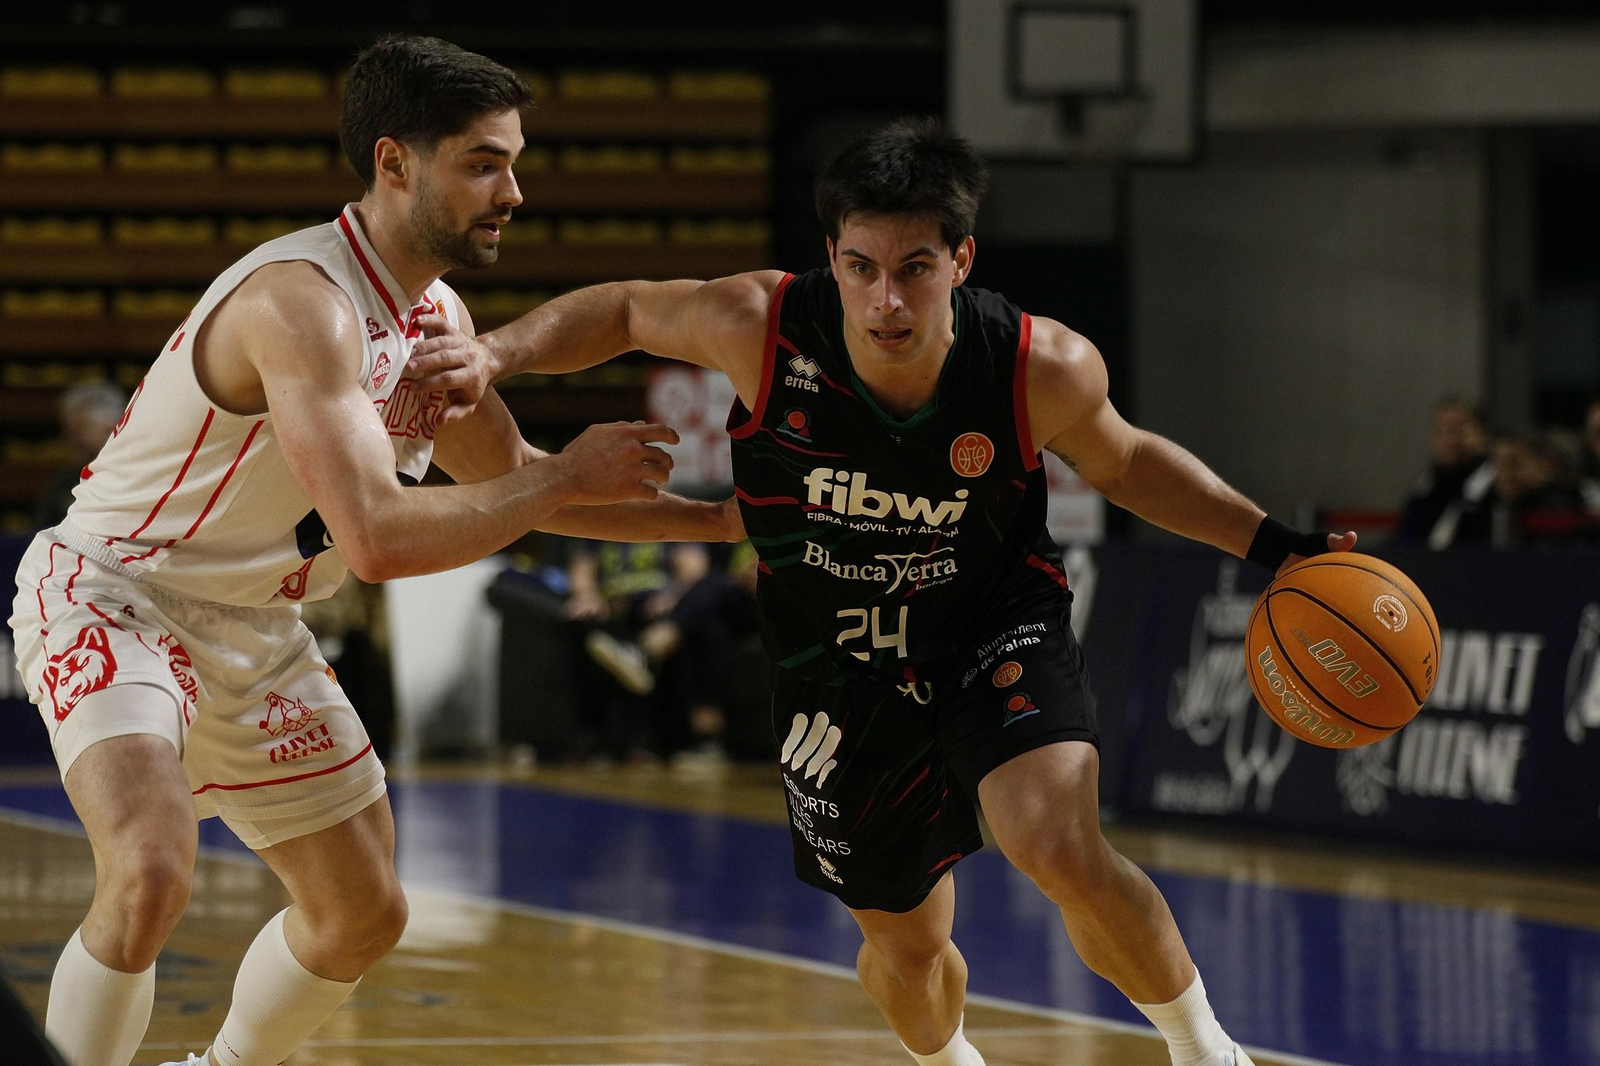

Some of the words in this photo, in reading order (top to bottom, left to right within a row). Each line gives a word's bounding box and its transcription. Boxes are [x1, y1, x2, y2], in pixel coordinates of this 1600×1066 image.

[785, 375, 819, 393] errea
[803, 467, 969, 527] fibwi
[806, 512, 842, 526] FIBRA
[850, 520, 889, 533] MÓVIL
[896, 525, 912, 536] TV
[836, 605, 908, 661] 24
[1257, 645, 1356, 745] Wilson
[1307, 638, 1380, 698] EVO
[269, 722, 329, 764] OLIVET
